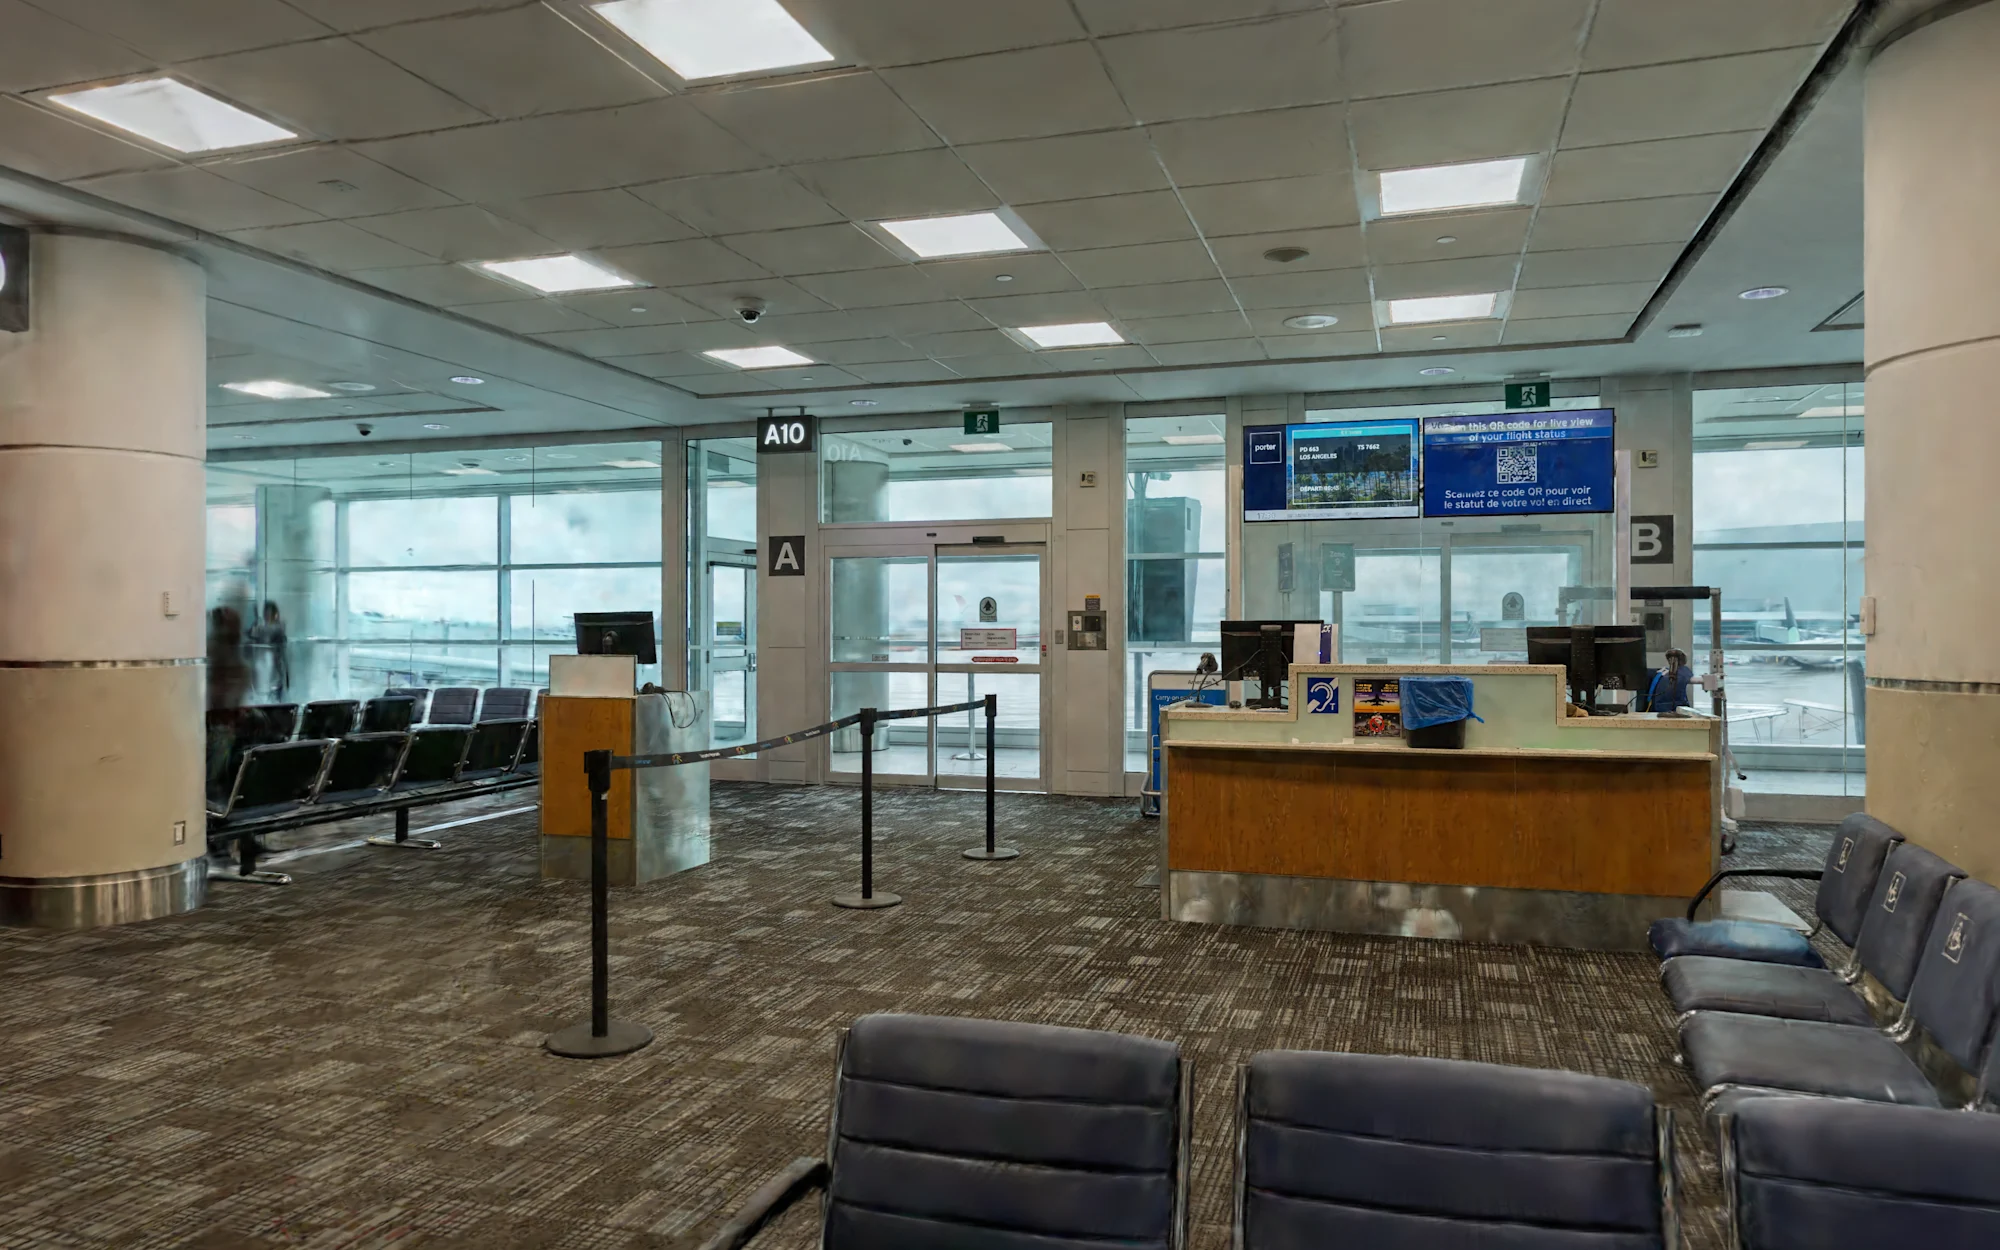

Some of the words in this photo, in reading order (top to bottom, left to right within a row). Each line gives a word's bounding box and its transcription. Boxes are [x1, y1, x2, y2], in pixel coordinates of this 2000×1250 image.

[1468, 422, 1487, 431] this
[1489, 421, 1505, 431] QR
[1507, 420, 1531, 429] code
[1533, 419, 1548, 428] for
[1550, 418, 1568, 427] live
[1570, 417, 1594, 426] view
[764, 422, 805, 445] A10
[1469, 432, 1478, 442] of
[1481, 433, 1504, 443] your
[1506, 430, 1532, 442] flight
[1534, 430, 1566, 439] status
[1255, 443, 1276, 452] porter
[1445, 489, 1485, 499] Scannez
[1487, 490, 1499, 498] ce
[1501, 488, 1525, 497] code
[1527, 487, 1543, 497] QR
[1545, 487, 1568, 497] pour
[1571, 485, 1591, 495] voir
[1444, 500, 1453, 509] le
[1455, 499, 1484, 509] statut
[1487, 498, 1499, 508] de
[1501, 498, 1527, 507] votre
[1530, 497, 1545, 507] vol
[1547, 498, 1560, 506] en
[1562, 496, 1592, 506] direct
[1631, 522, 1663, 557] B
[774, 541, 800, 571] A
